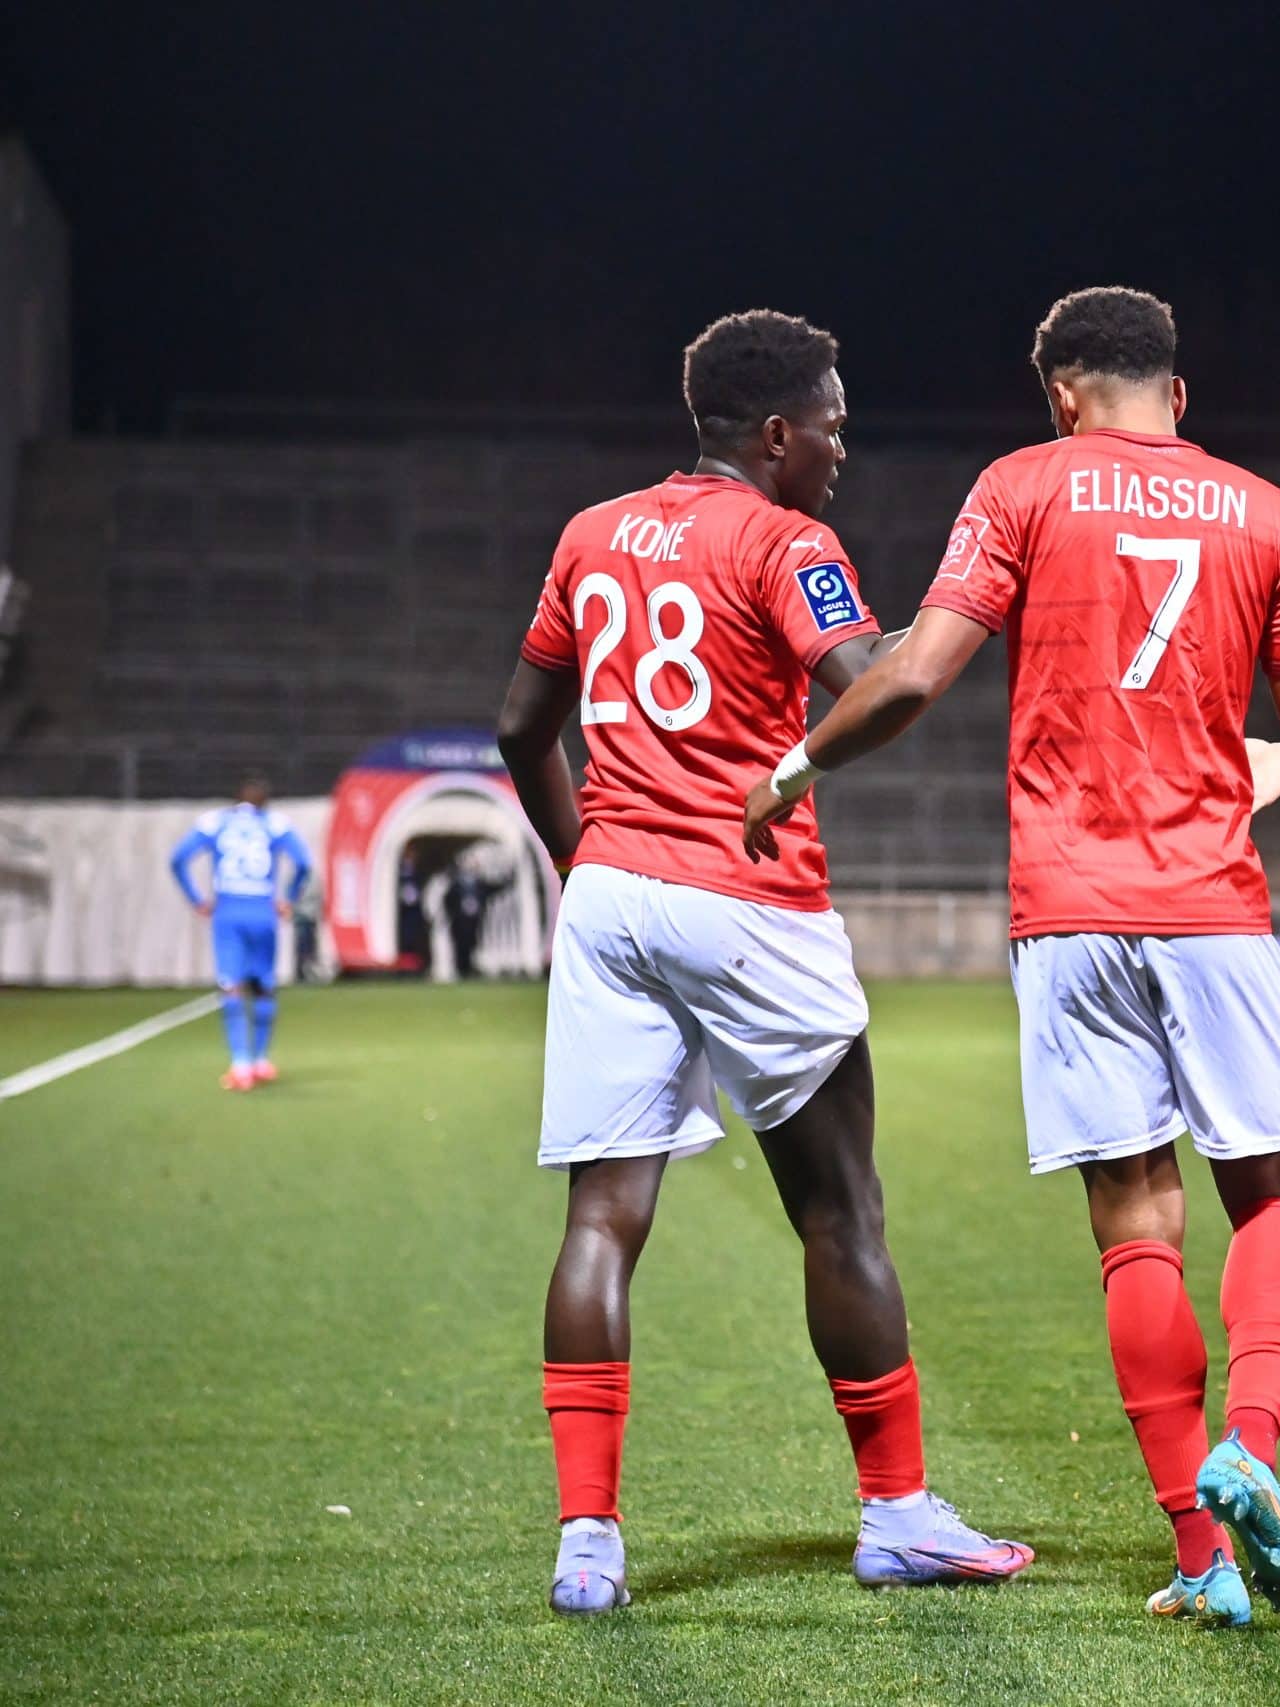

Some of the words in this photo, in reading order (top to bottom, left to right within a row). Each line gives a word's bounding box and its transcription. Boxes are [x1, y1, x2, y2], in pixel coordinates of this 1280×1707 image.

[609, 512, 697, 563] KONÉ
[573, 572, 711, 733] 28
[817, 601, 845, 615] LIGUE
[844, 600, 852, 608] 2
[1116, 533, 1200, 689] 7
